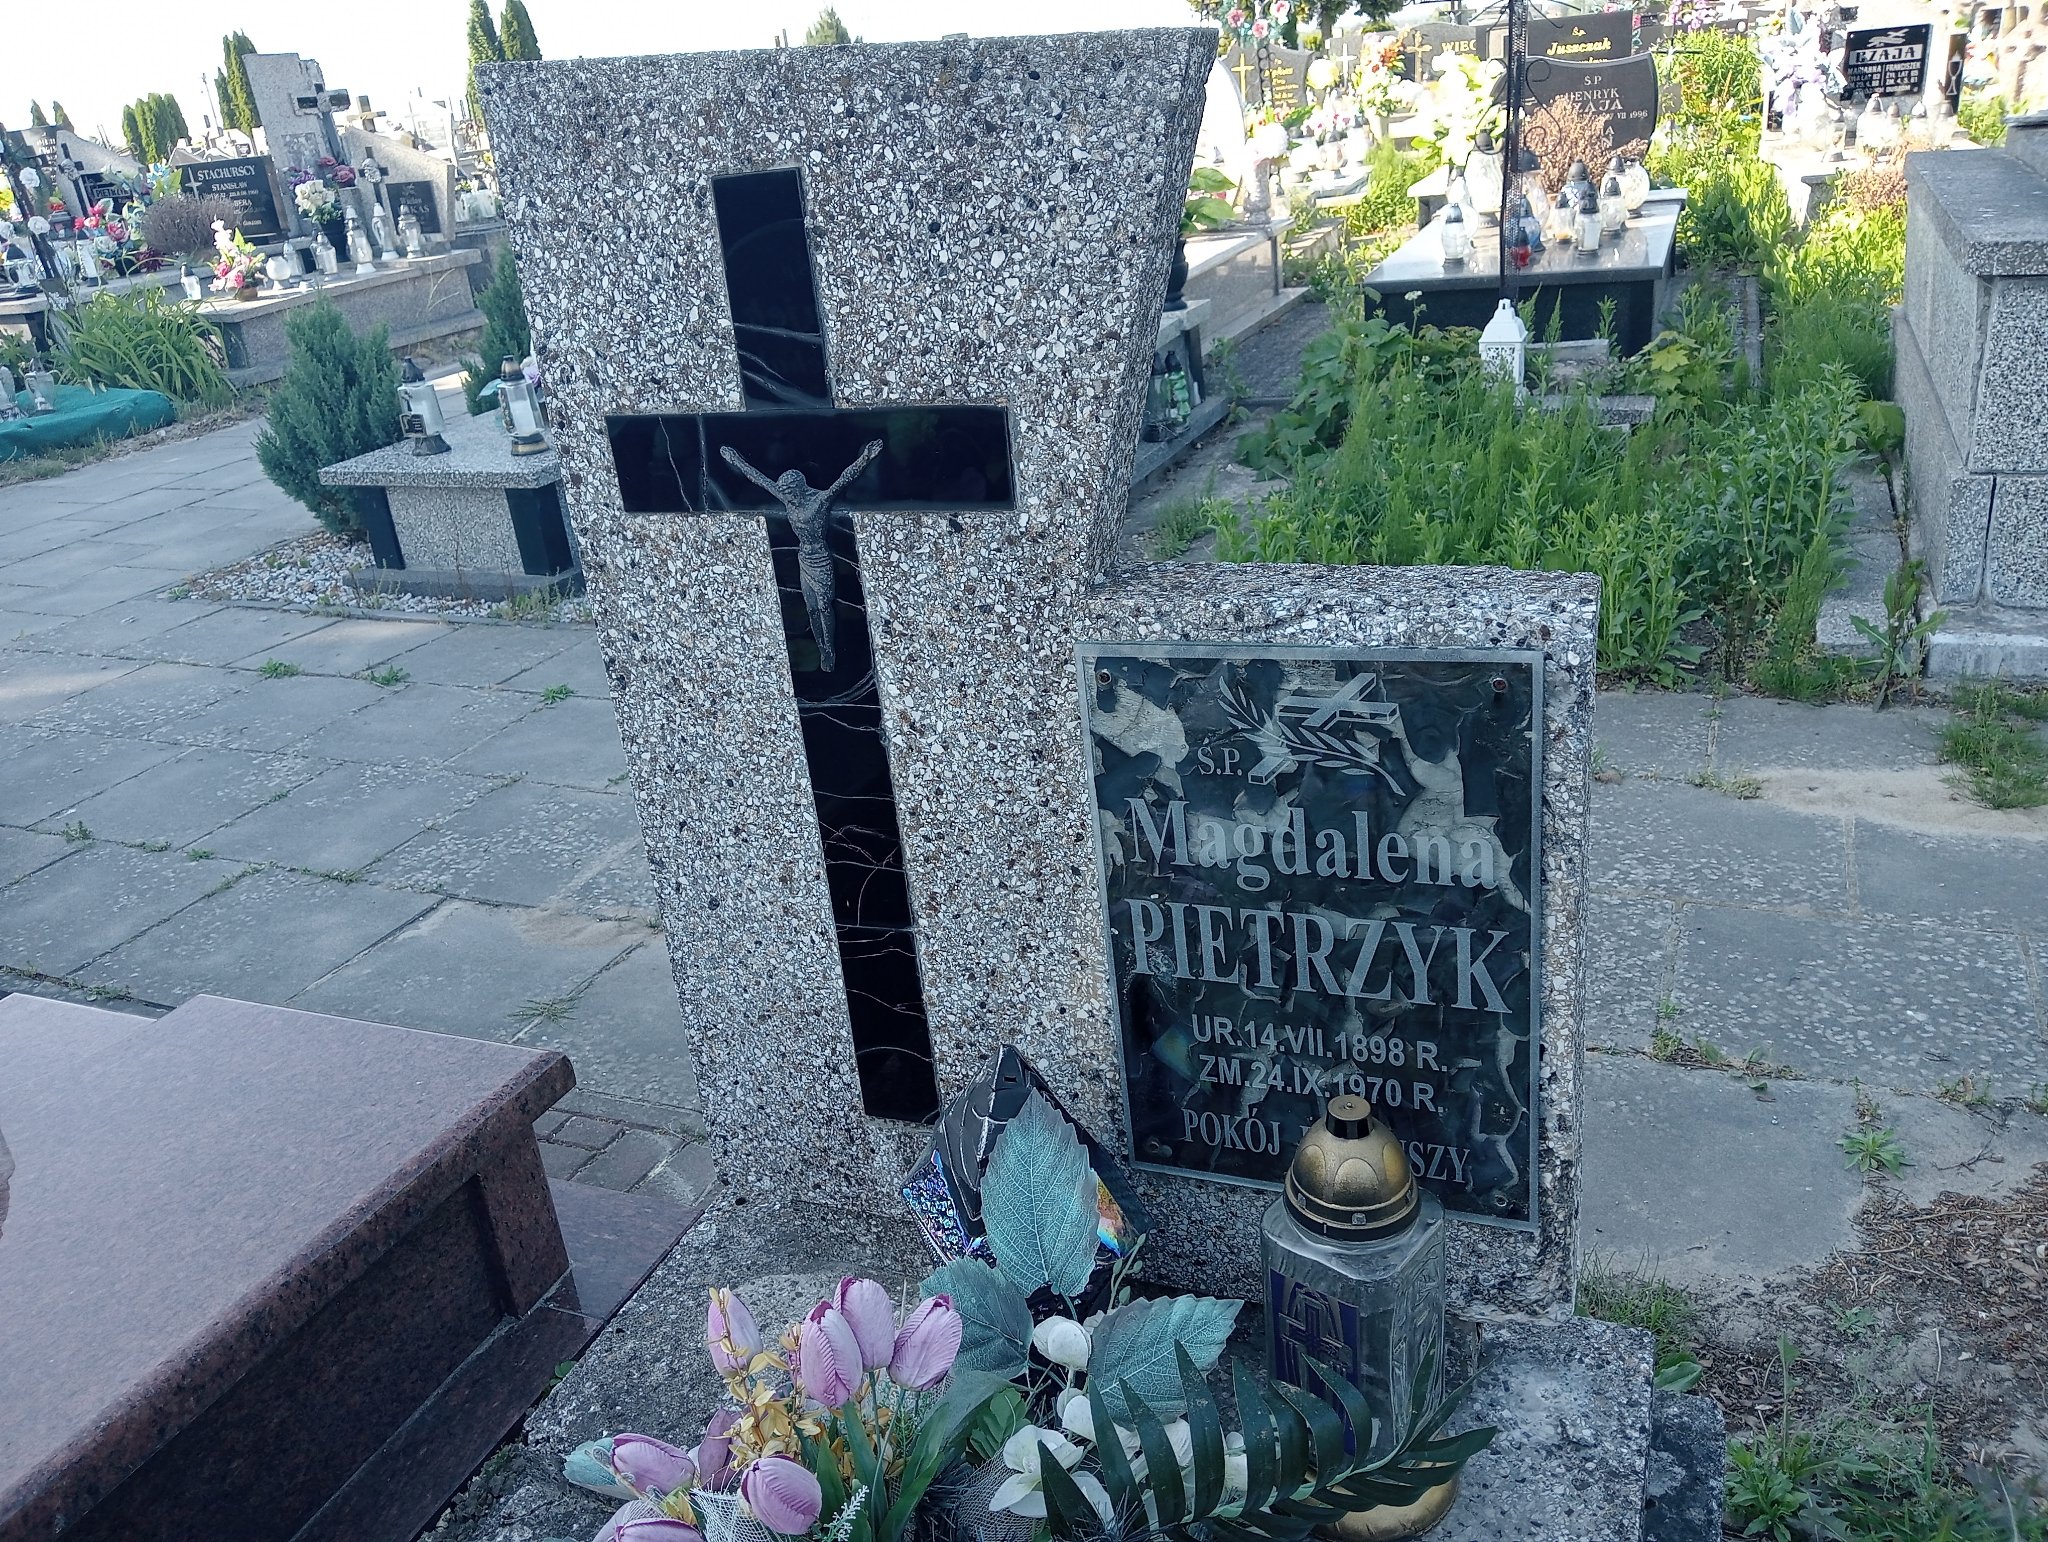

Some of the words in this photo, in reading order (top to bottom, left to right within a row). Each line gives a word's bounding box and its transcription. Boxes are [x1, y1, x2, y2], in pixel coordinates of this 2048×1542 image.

[1546, 37, 1612, 56] Juszczak
[197, 165, 255, 181] STACHURSCY
[1124, 797, 1499, 892] Magdalena
[1124, 898, 1512, 1014] PIETRZYK
[1416, 1040, 1448, 1073] R.
[1413, 1082, 1444, 1113] R.
[1181, 1107, 1280, 1156] POKÓJ
[1400, 1139, 1470, 1183] SZY
